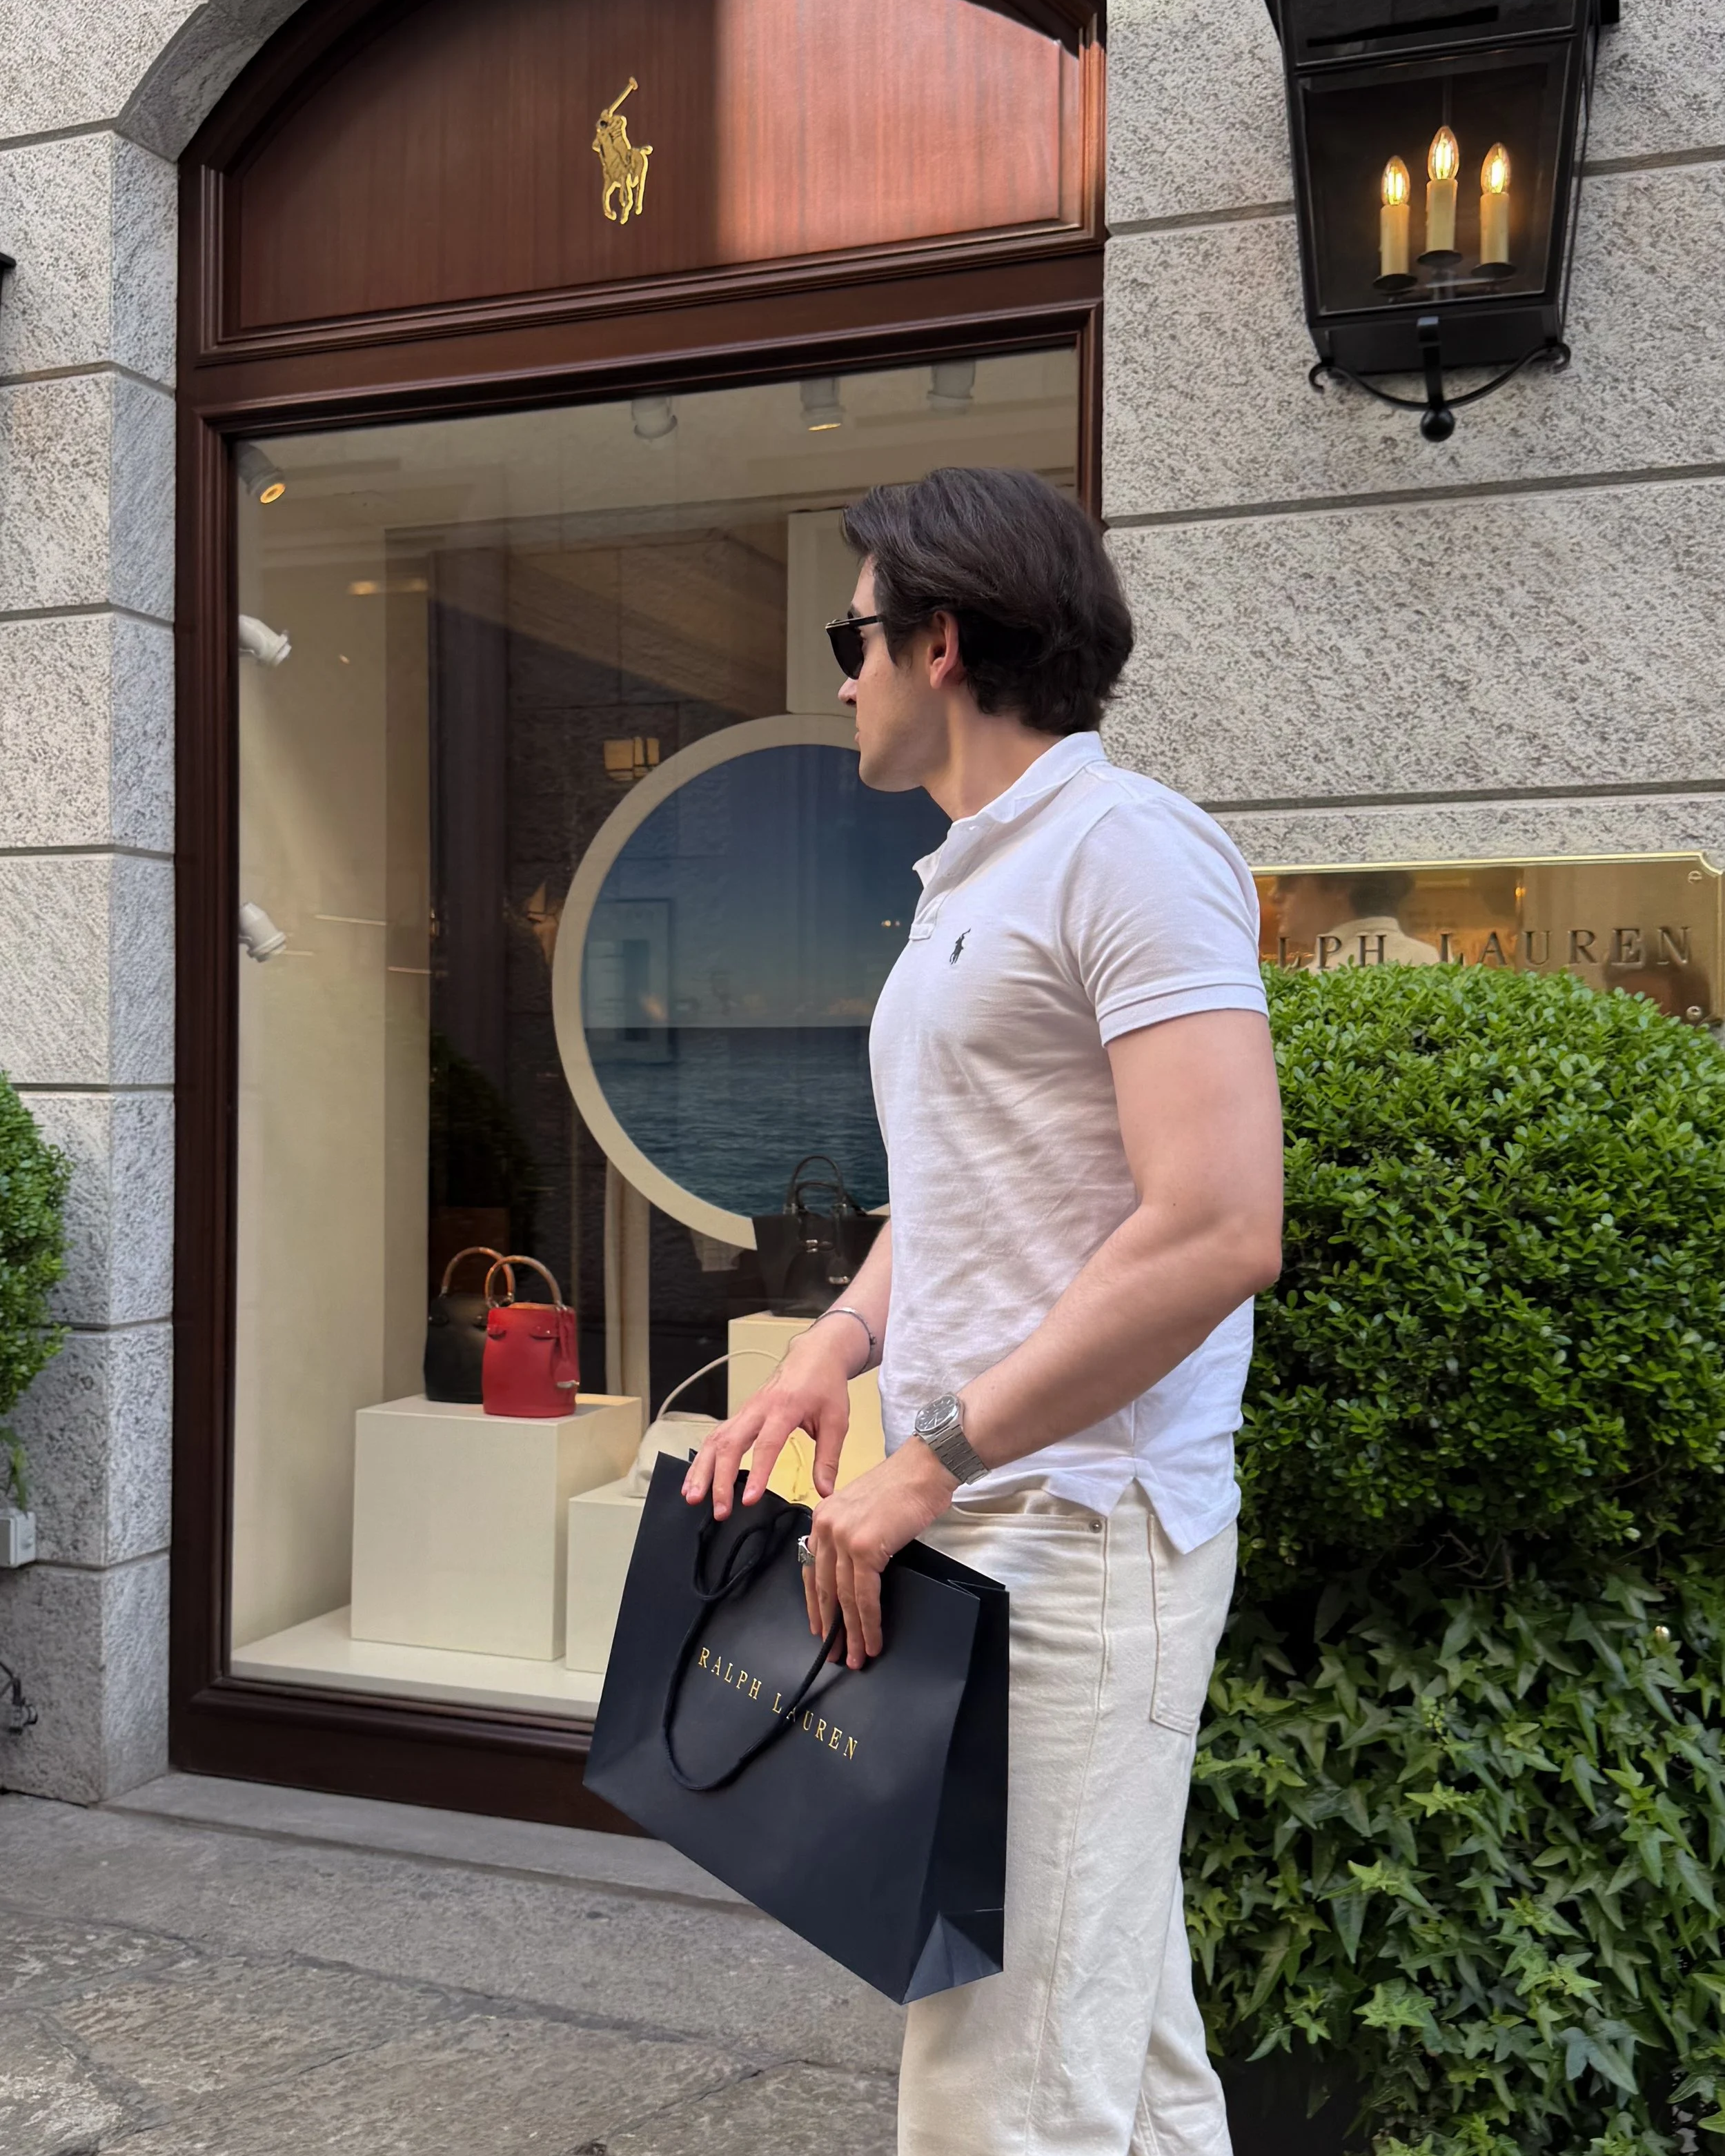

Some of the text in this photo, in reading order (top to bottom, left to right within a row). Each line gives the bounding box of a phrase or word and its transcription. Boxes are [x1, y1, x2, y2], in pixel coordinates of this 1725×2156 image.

[1279, 925, 1693, 969] LPH LAUREN
[698, 1646, 858, 1760] RALPH LAUREN
